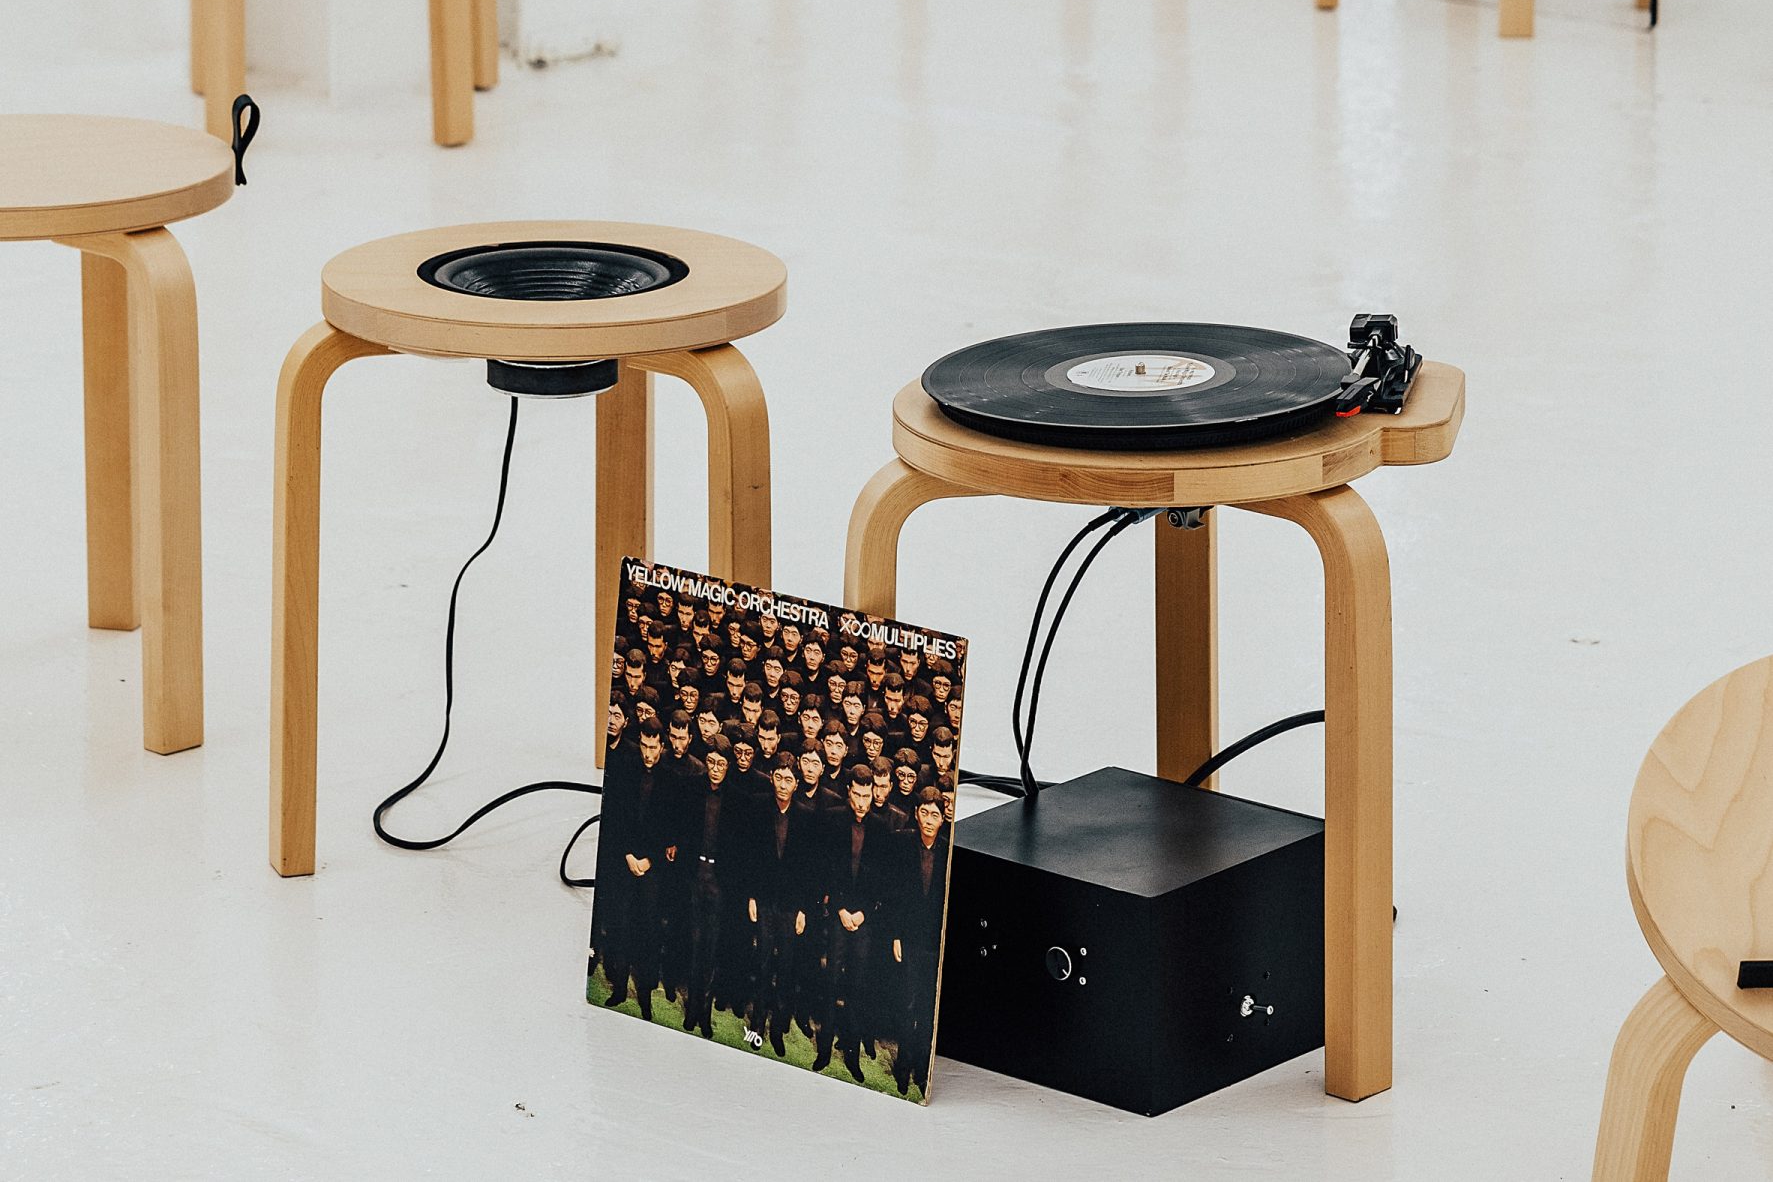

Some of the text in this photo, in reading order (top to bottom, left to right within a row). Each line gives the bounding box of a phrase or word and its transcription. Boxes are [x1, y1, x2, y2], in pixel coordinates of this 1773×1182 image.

[626, 563, 686, 593] YELLOW
[687, 578, 735, 606] MAGIC
[738, 591, 830, 629] ORCHESTRA
